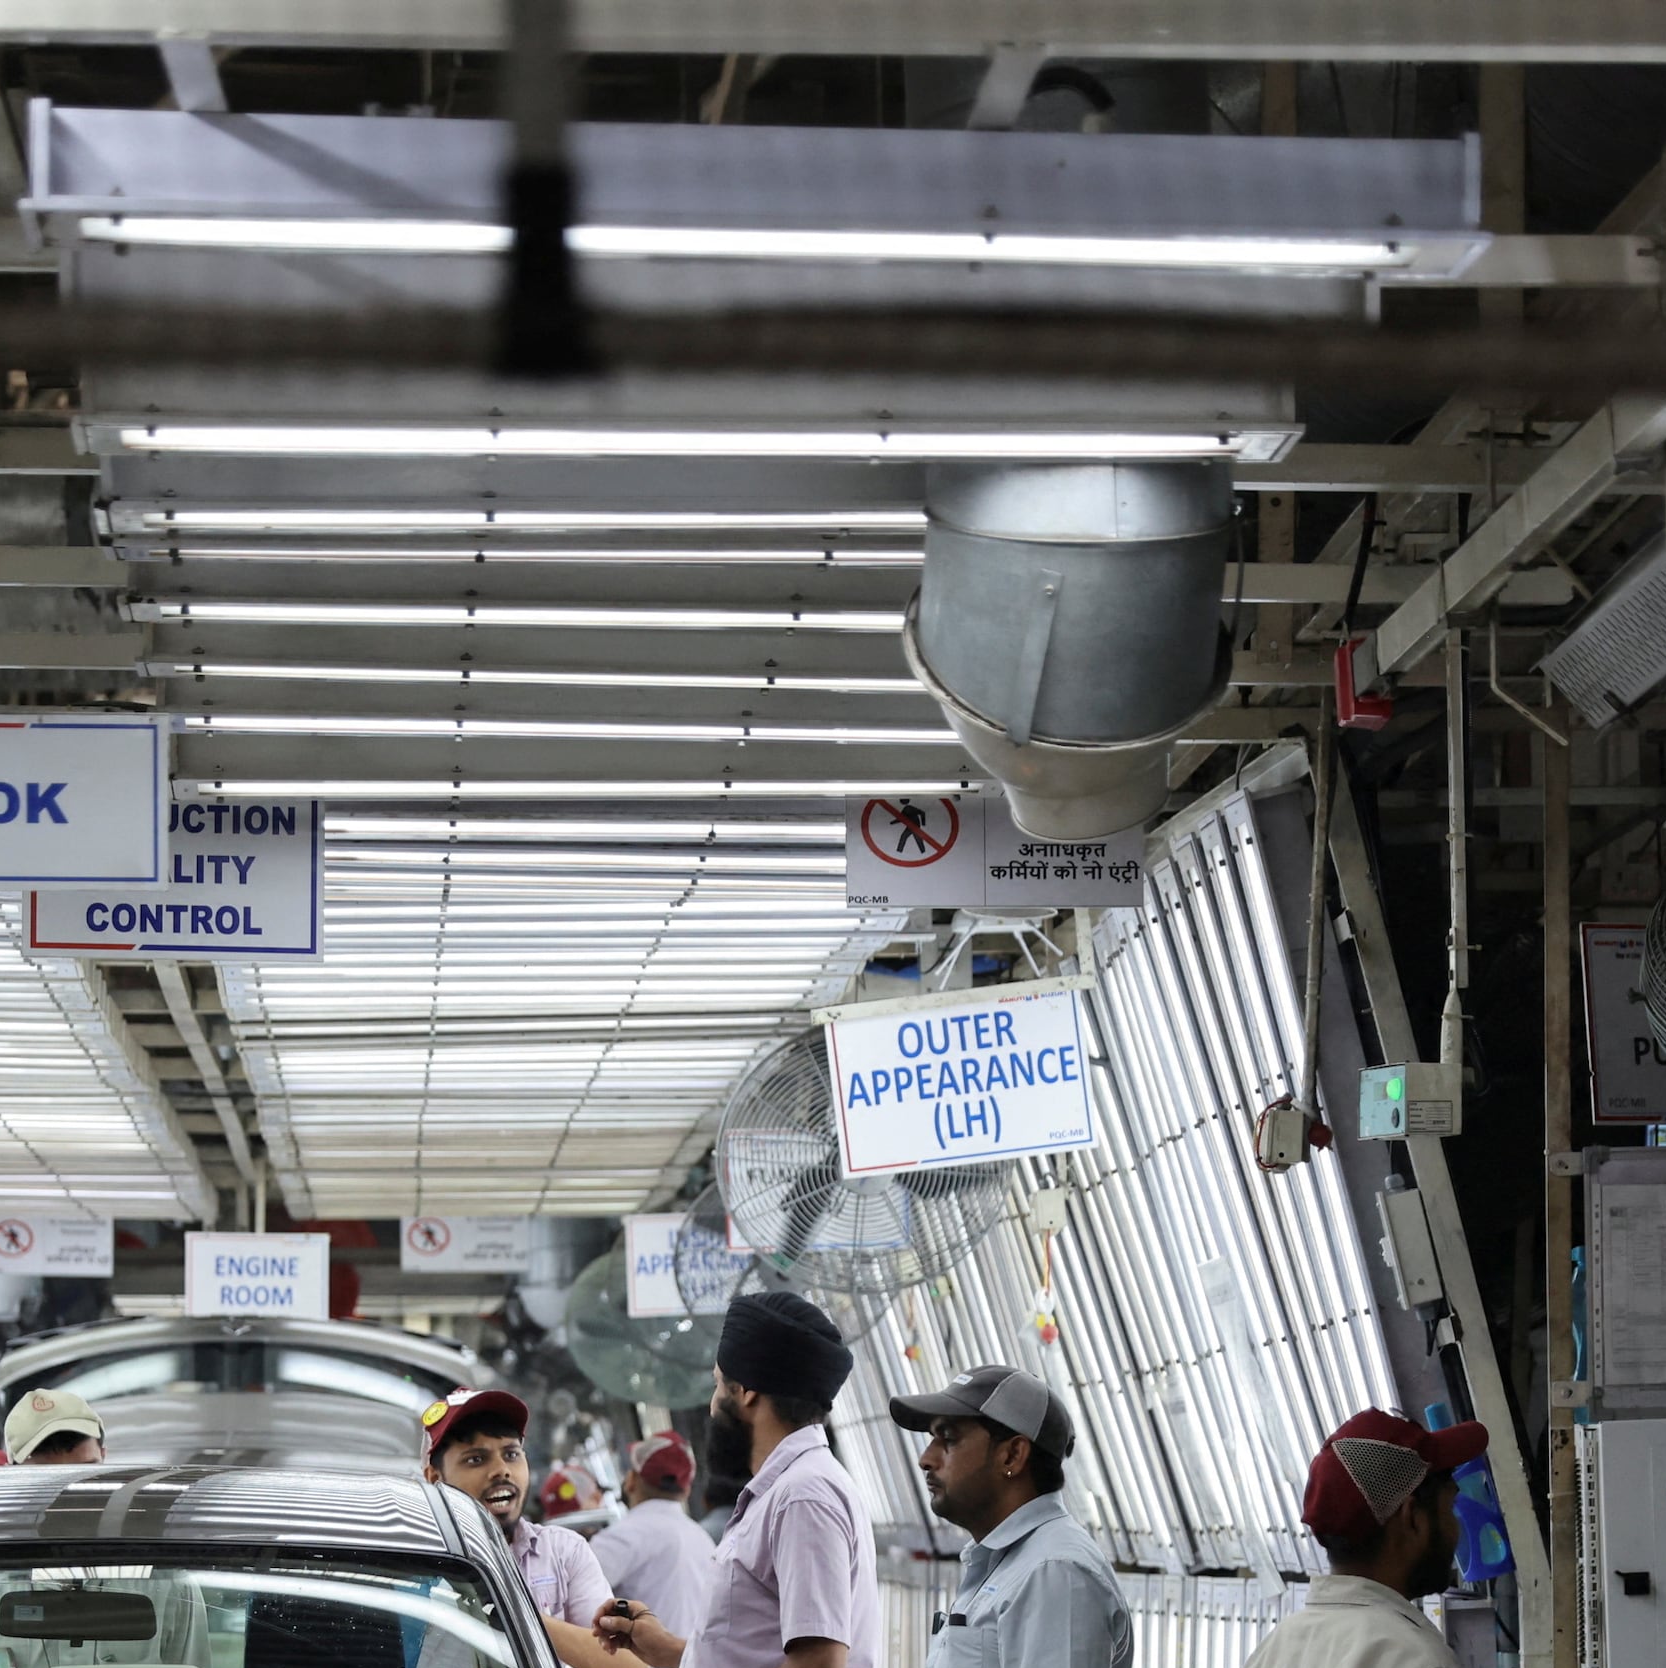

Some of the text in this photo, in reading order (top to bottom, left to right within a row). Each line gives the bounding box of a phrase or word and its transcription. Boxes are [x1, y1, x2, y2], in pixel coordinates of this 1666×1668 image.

[168, 804, 296, 835] CTION
[168, 854, 256, 885] LITY
[989, 858, 1140, 884] कर्मियों को नो एंट्री
[848, 895, 889, 904] PQC-MB
[86, 902, 262, 935] CONTROL
[897, 1010, 1017, 1058] OUTER
[847, 1046, 1078, 1109] APPEARANCE
[934, 1095, 1001, 1149] (LH)
[1049, 1128, 1084, 1139] PQC-MB
[215, 1256, 299, 1277] ENGINE
[220, 1286, 293, 1305] ROOM
